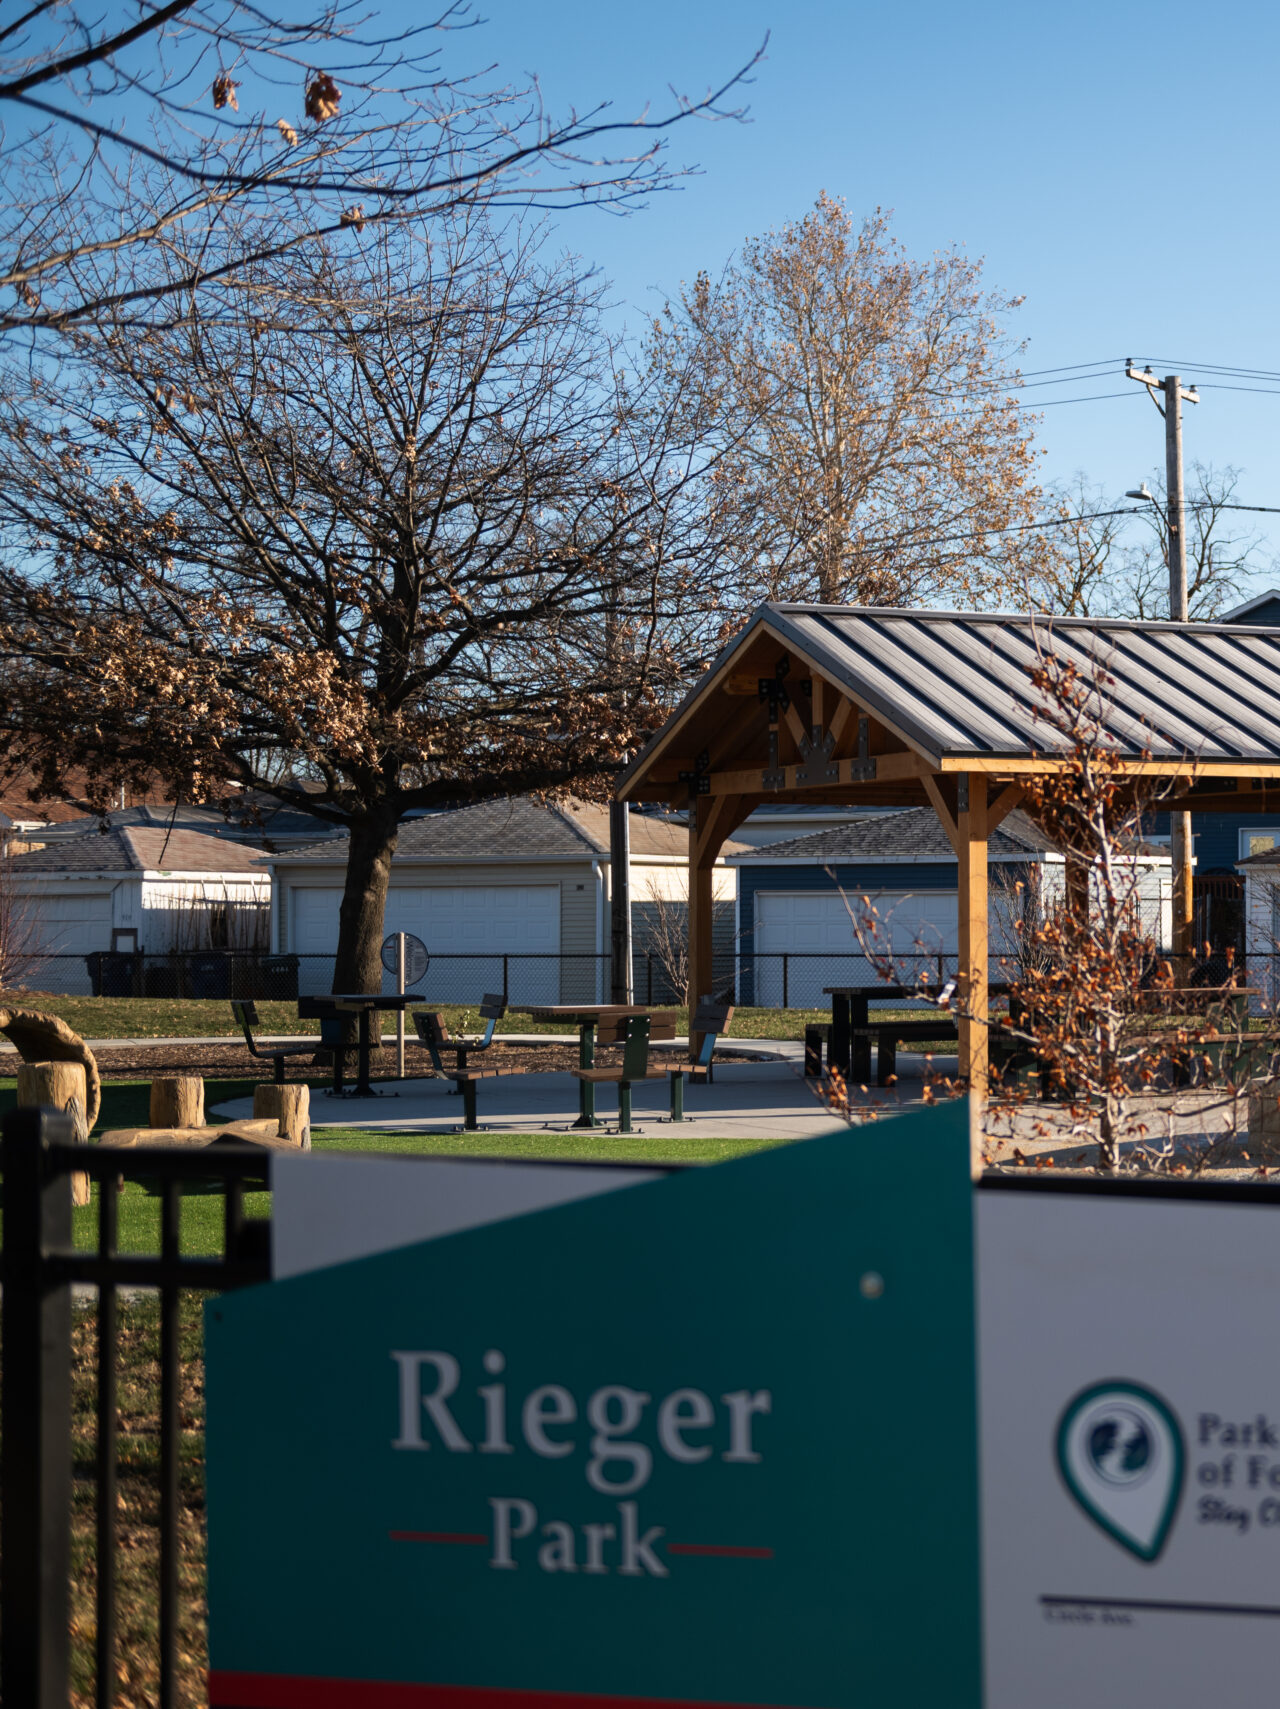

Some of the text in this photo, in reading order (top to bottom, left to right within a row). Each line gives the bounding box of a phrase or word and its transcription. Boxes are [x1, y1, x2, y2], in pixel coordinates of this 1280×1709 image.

[389, 1348, 772, 1495] Rieger
[1197, 1411, 1280, 1450] Park
[1196, 1452, 1237, 1488] of
[488, 1496, 671, 1578] Park
